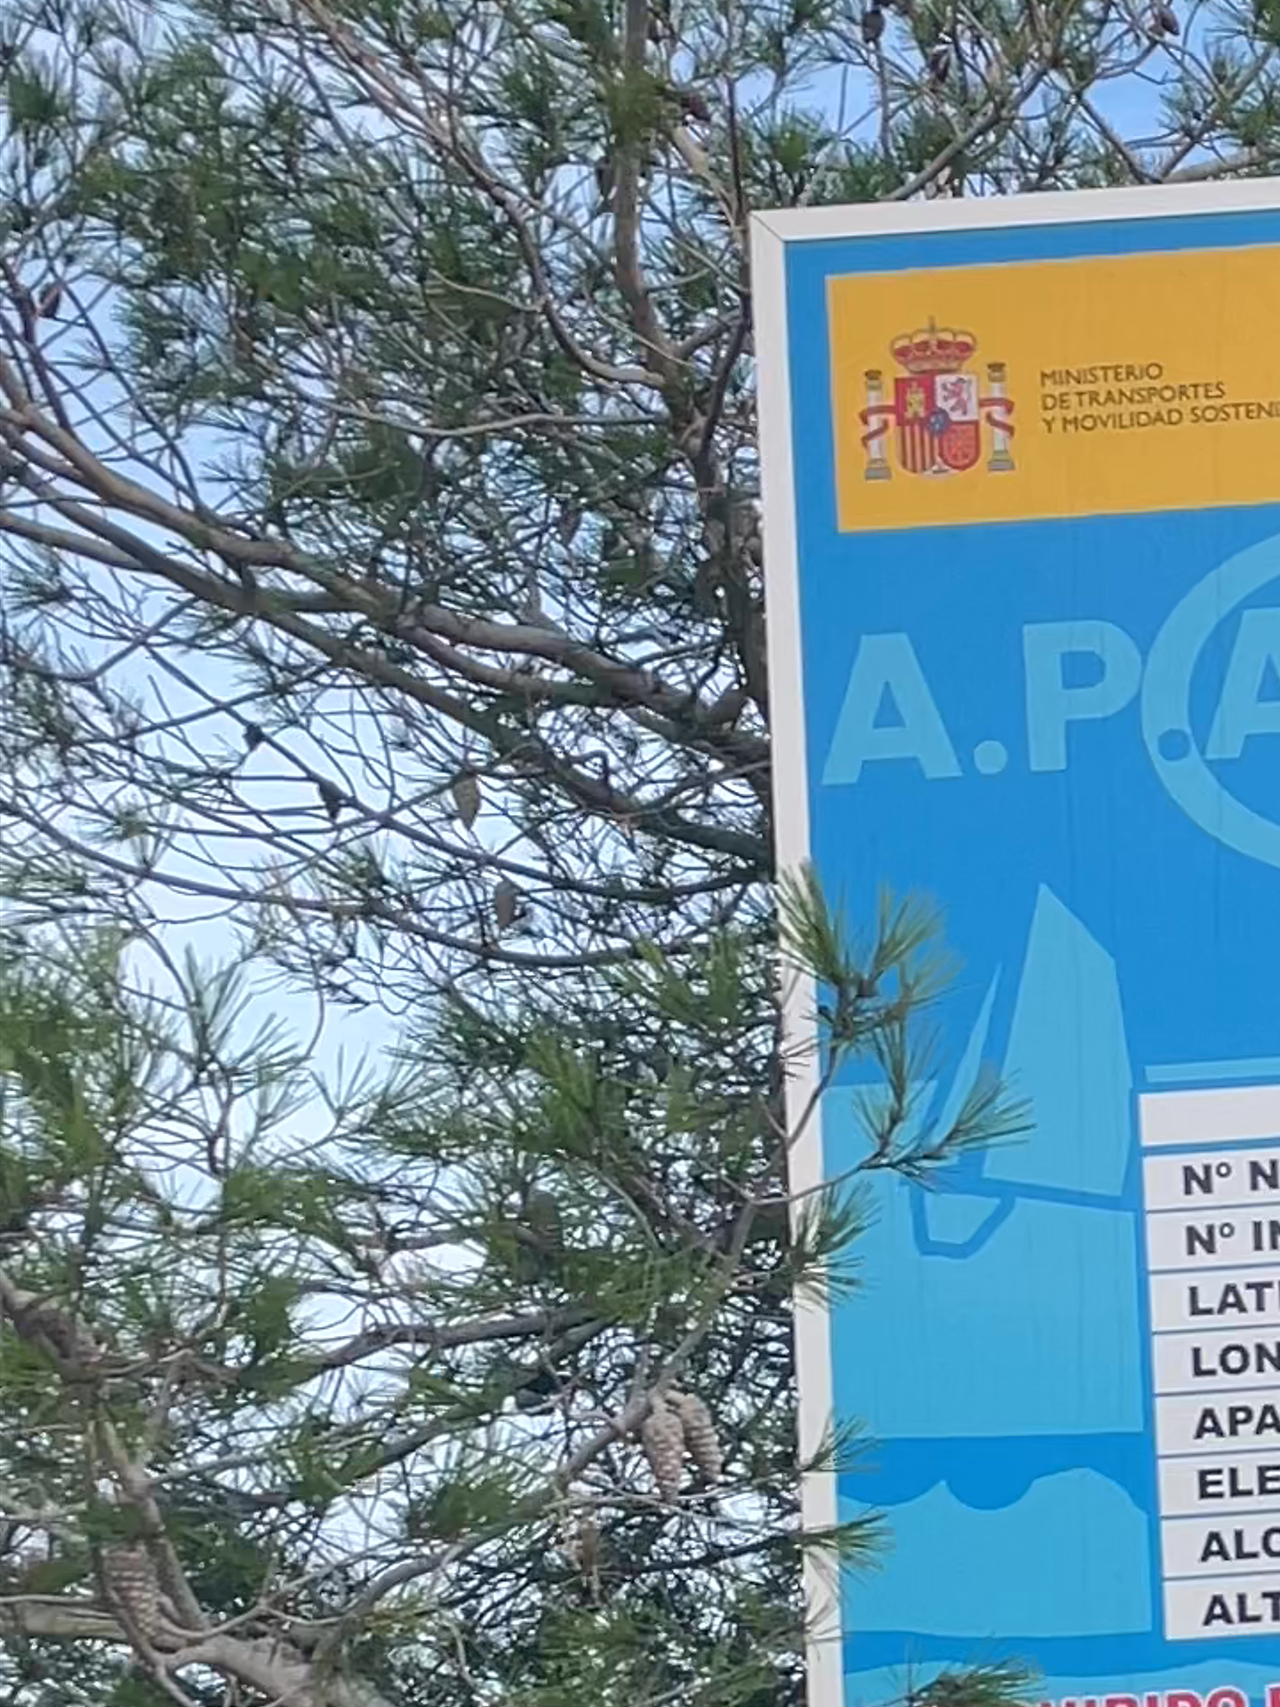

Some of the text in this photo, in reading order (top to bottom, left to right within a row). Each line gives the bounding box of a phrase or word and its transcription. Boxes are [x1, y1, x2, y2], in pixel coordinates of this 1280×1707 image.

[1040, 362, 1163, 387] MINISTERIO
[1042, 382, 1226, 411] DE TRANSPORTES
[1041, 416, 1056, 434] Y
[1062, 408, 1183, 433] MOVILIDAD
